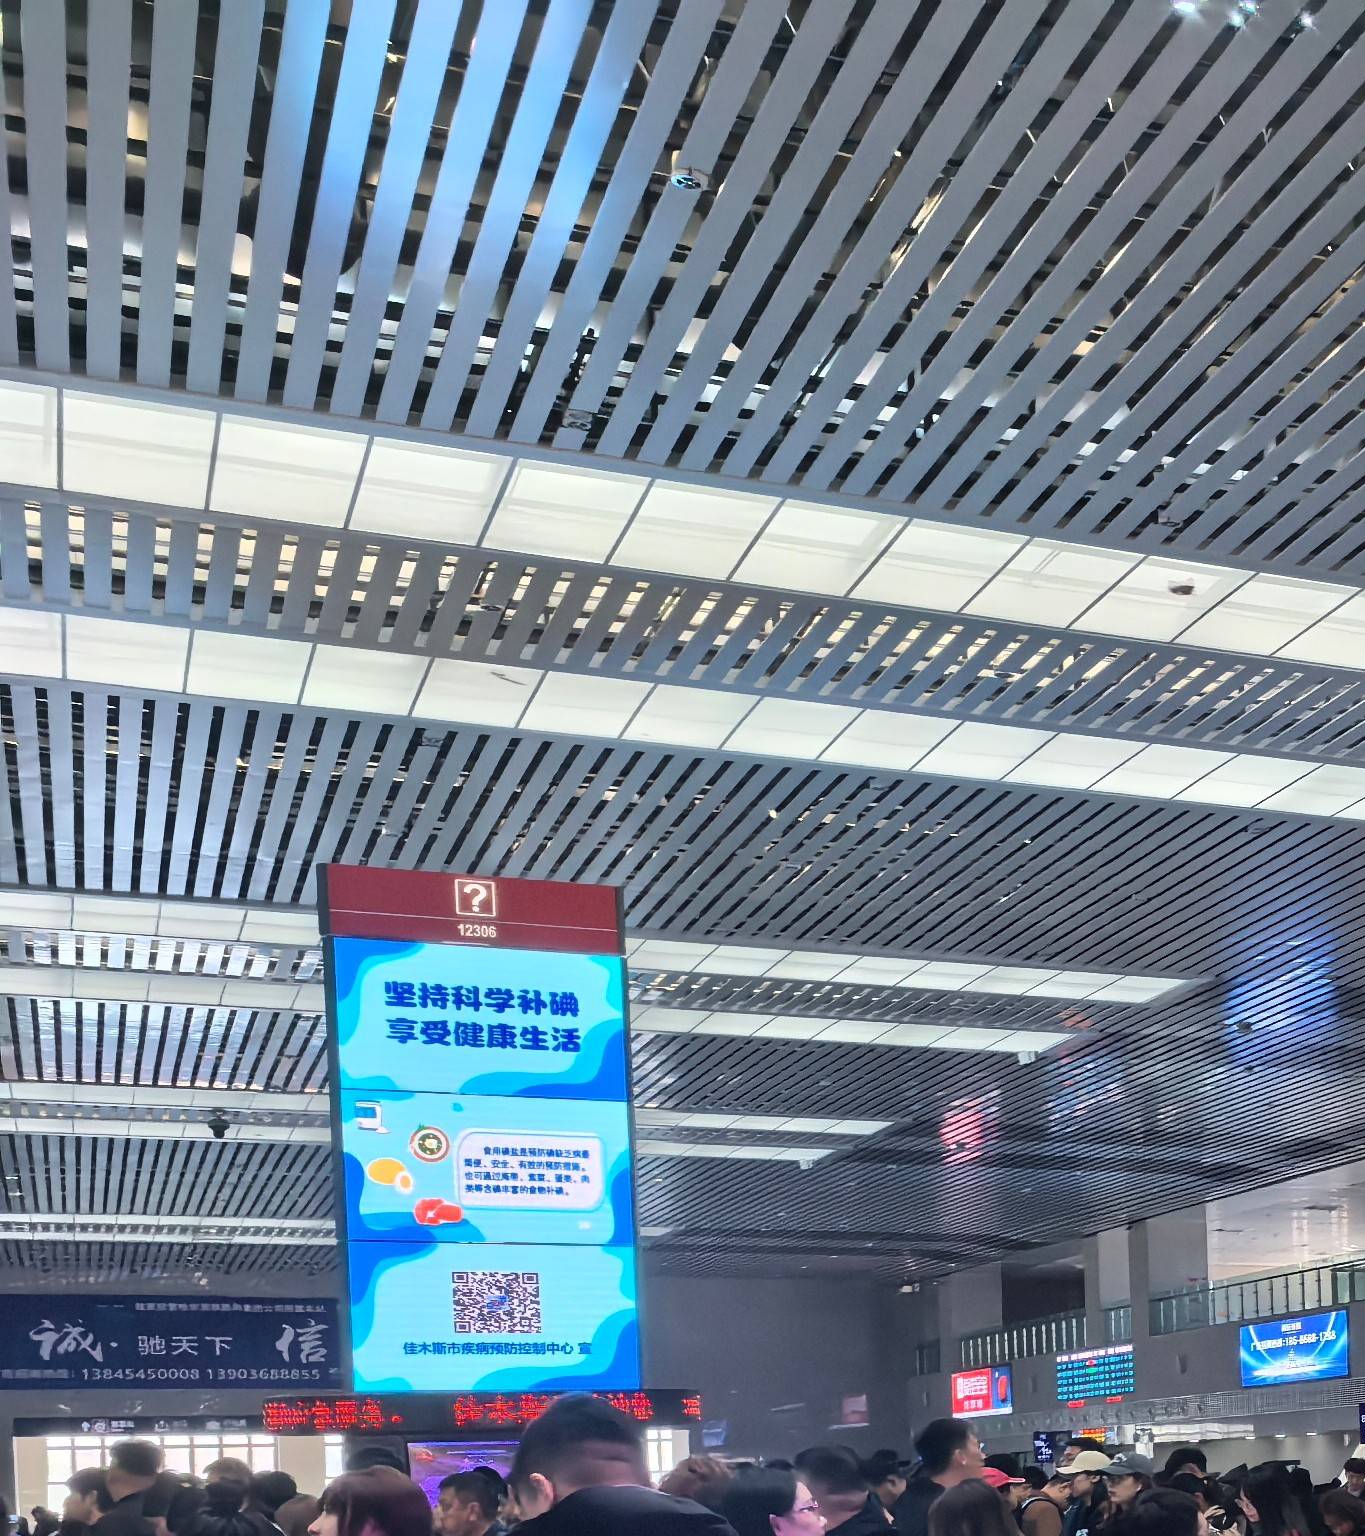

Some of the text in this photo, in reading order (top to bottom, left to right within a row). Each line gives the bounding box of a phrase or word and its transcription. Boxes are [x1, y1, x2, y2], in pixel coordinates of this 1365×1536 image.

[457, 923, 497, 938] 12306
[384, 980, 580, 1018] 坚持科学补碘
[386, 1017, 581, 1053] 享受健康生活
[137, 1335, 233, 1355] 驰天下
[274, 1318, 329, 1364] 信
[403, 1341, 573, 1355] 佳木斯市疾病预防控制中心
